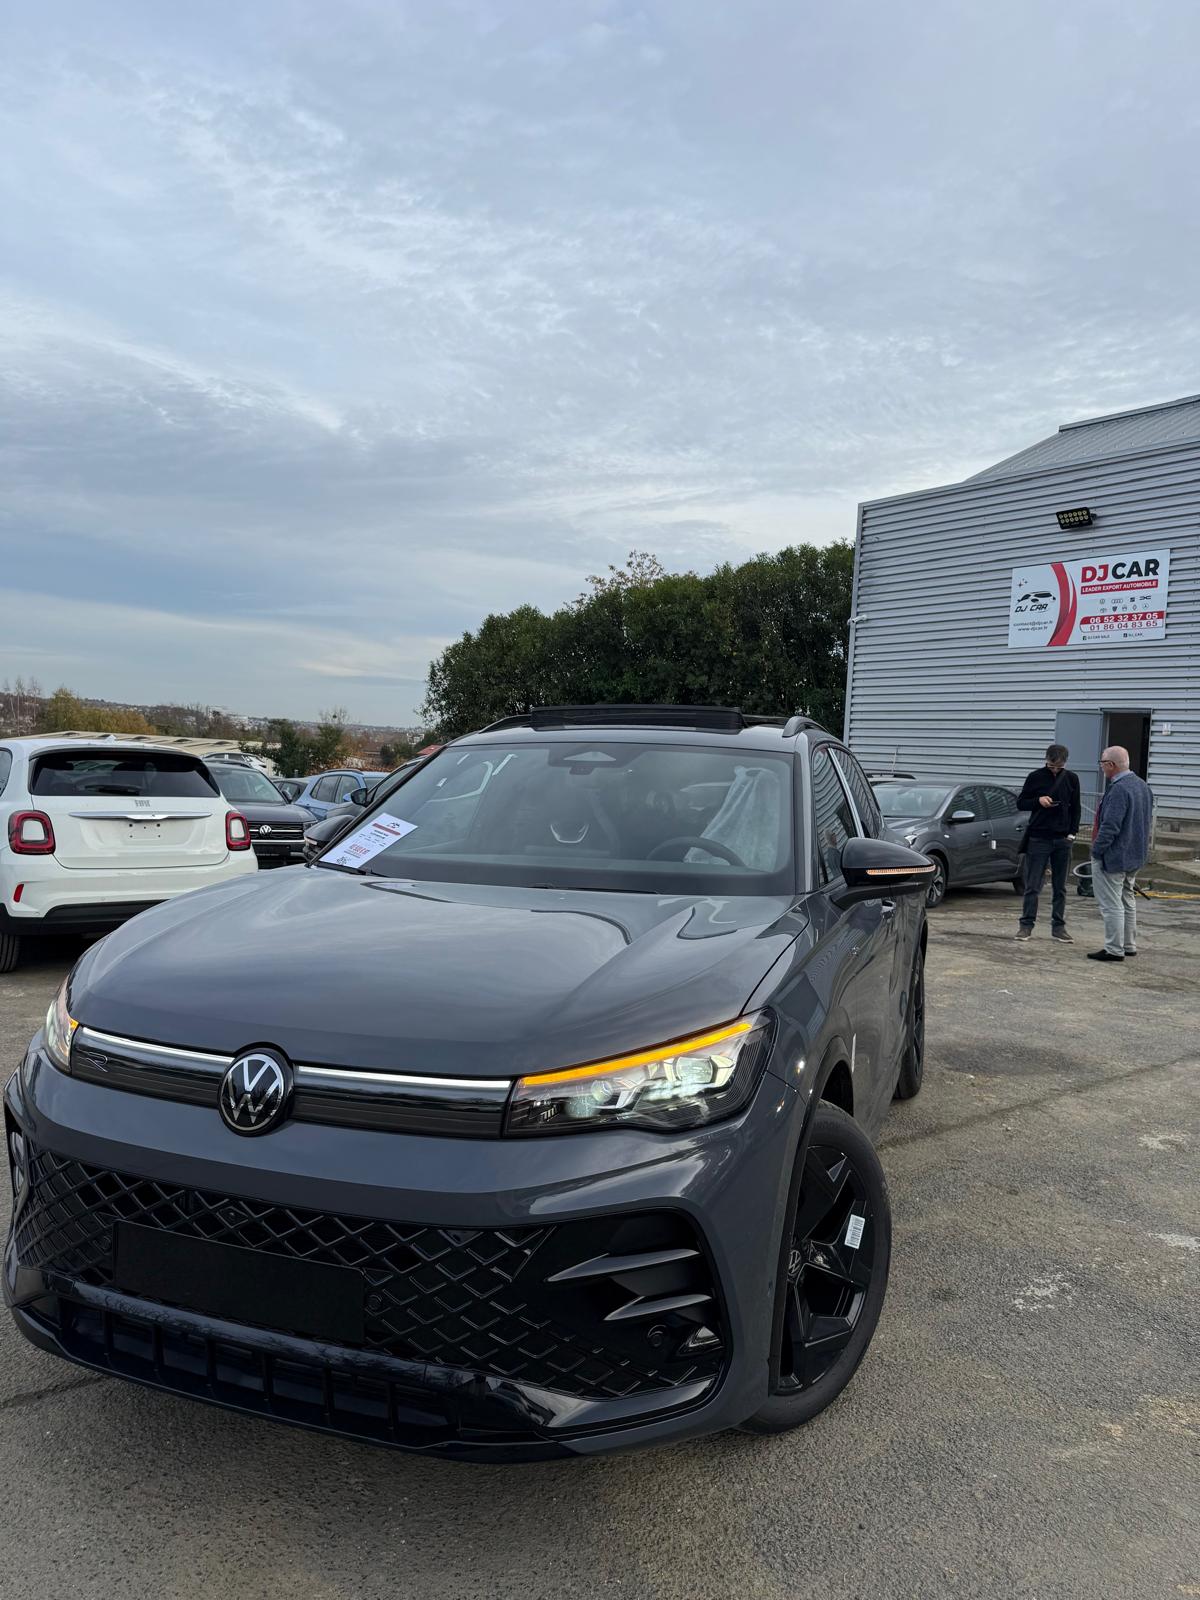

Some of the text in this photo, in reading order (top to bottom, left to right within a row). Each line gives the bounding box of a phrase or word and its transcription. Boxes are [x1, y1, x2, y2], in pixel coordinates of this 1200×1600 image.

[1122, 580, 1157, 589] AUTOMOBILE
[1015, 603, 1049, 613] DJ CAR
[1103, 615, 1115, 623] 52
[1117, 614, 1129, 622] 32
[1131, 613, 1143, 621] 37
[1145, 612, 1158, 620] 05
[1131, 621, 1143, 629] 83
